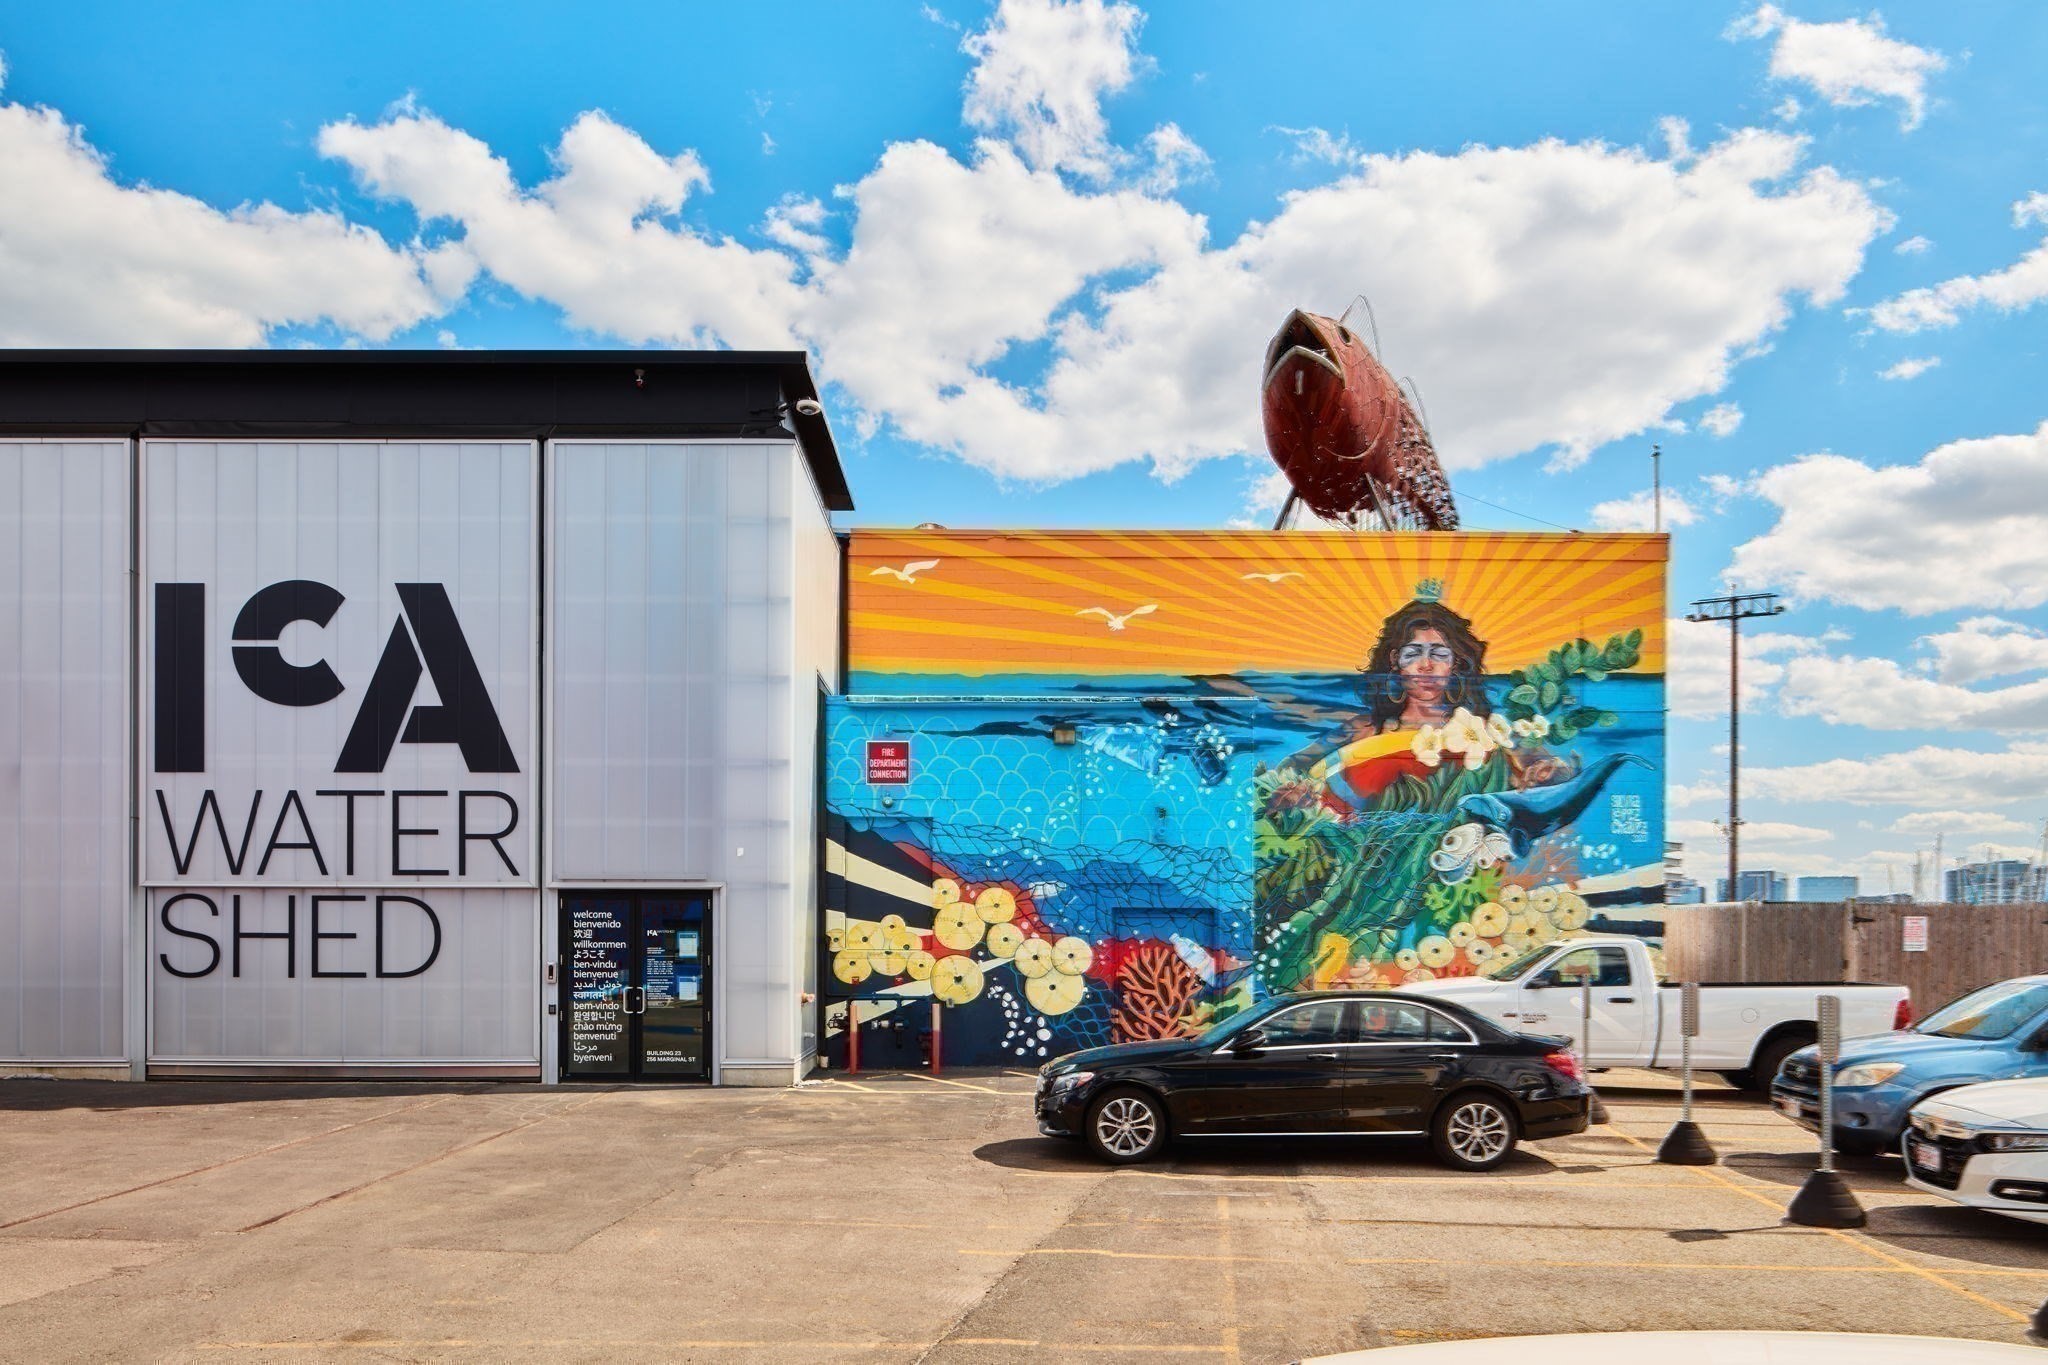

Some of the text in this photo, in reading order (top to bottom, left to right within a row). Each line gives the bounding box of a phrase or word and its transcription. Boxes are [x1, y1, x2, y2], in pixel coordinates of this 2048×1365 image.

[155, 579, 520, 773] ICA
[881, 747, 895, 757] FIRE
[869, 758, 907, 768] DEPARTMENT
[869, 769, 907, 779] CONNECTION
[155, 789, 520, 876] WATER
[573, 909, 613, 919] welcome
[573, 919, 622, 929] bienvenido
[159, 893, 442, 979] SHED
[573, 929, 593, 939] 欢迎
[573, 939, 627, 949] willkommen
[573, 949, 606, 959] ようこそ
[573, 959, 617, 969] ben-vindu
[573, 969, 619, 979] bienvenue
[573, 1001, 620, 1010] bem-vindo
[573, 1010, 616, 1021] 환영합니다
[573, 1021, 595, 1031] chào
[573, 1031, 617, 1041] benvenuti
[573, 1052, 613, 1064] byenveni
